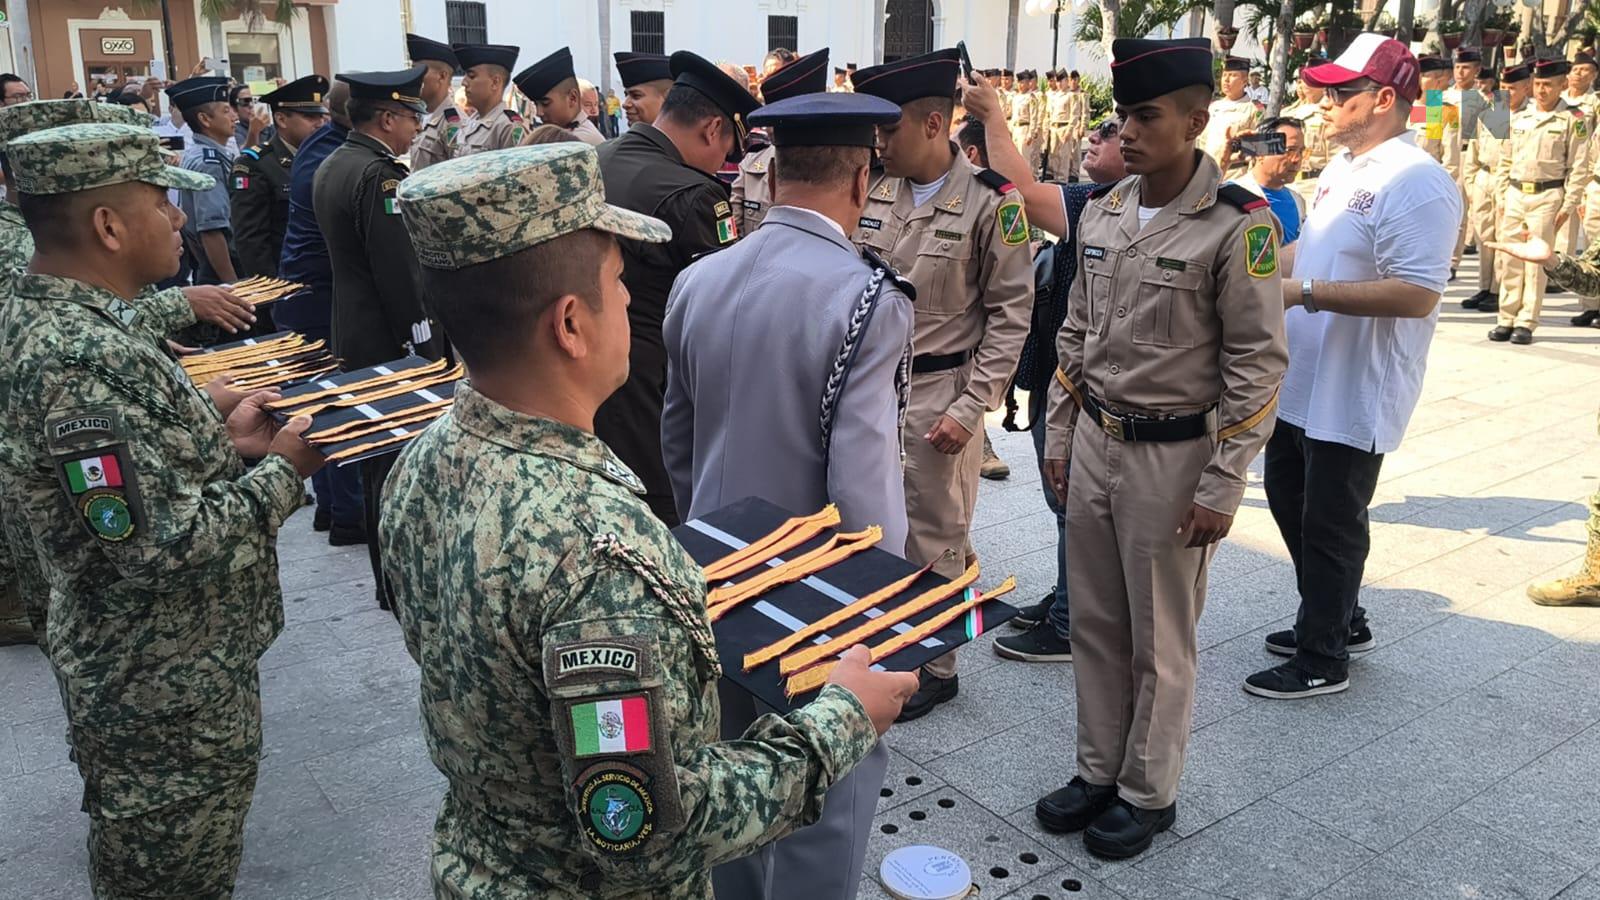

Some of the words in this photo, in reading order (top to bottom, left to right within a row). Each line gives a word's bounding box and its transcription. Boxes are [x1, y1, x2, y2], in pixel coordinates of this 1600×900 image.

[104, 40, 132, 51] OXXO
[58, 418, 109, 436] MEXICO
[561, 649, 635, 669] MEXICO
[602, 773, 631, 784] SERVICIO
